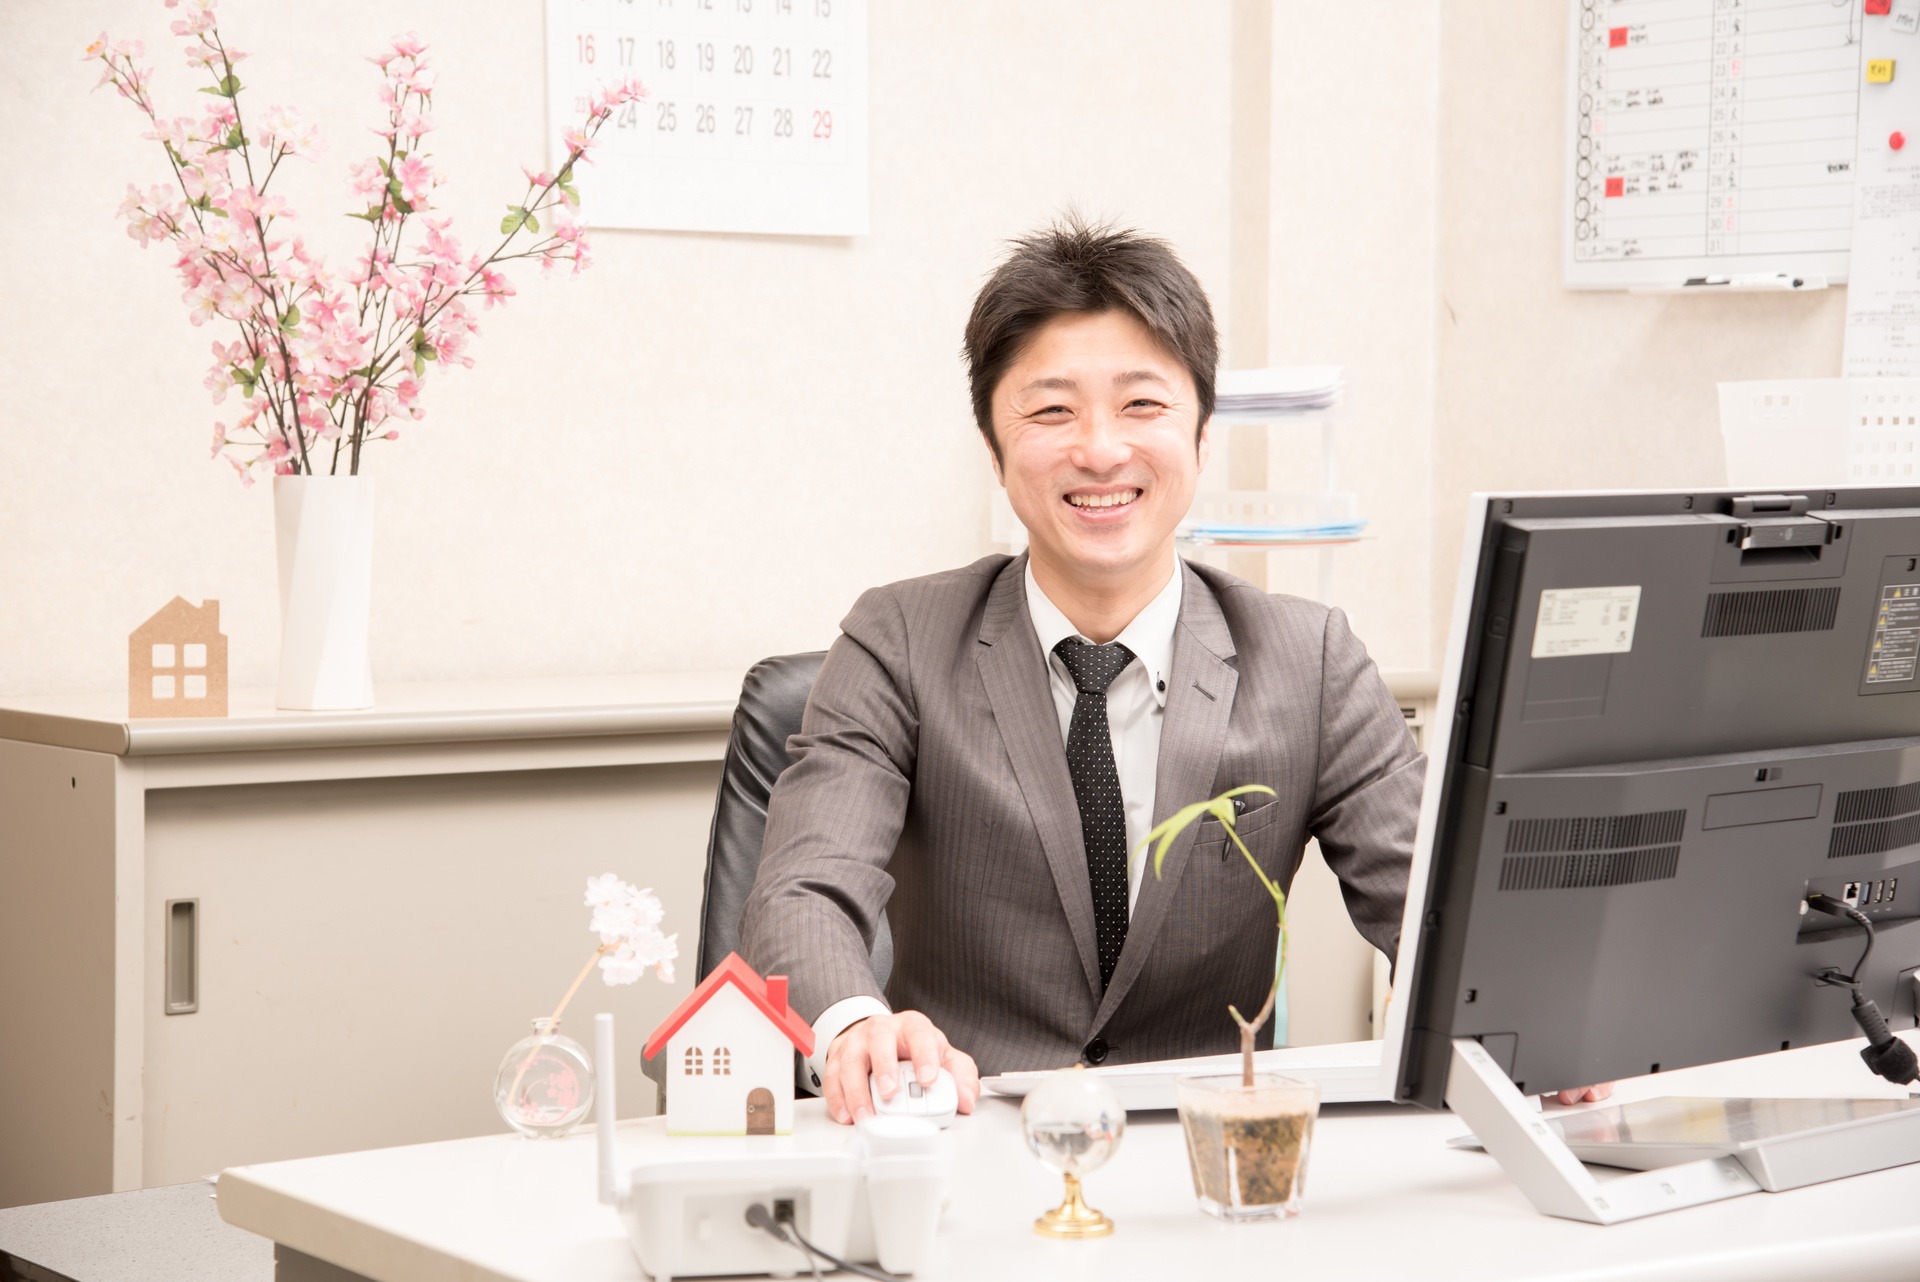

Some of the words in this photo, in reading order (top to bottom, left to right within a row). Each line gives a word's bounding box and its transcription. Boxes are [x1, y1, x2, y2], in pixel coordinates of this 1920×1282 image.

[576, 34, 595, 65] 16
[617, 37, 635, 67] 17
[657, 40, 676, 70] 18
[696, 42, 715, 72] 19
[734, 45, 753, 75] 20
[772, 47, 791, 77] 21
[812, 49, 832, 79] 22
[1715, 64, 1726, 76] 23
[1714, 87, 1725, 99] 24
[617, 101, 637, 129] 24
[657, 102, 677, 132] 25
[696, 104, 715, 134] 26
[734, 106, 754, 136] 27
[773, 108, 793, 138] 28
[813, 110, 833, 139] 29
[1712, 152, 1723, 164] 27
[1710, 218, 1721, 230] 30
[1709, 239, 1720, 252] 31
